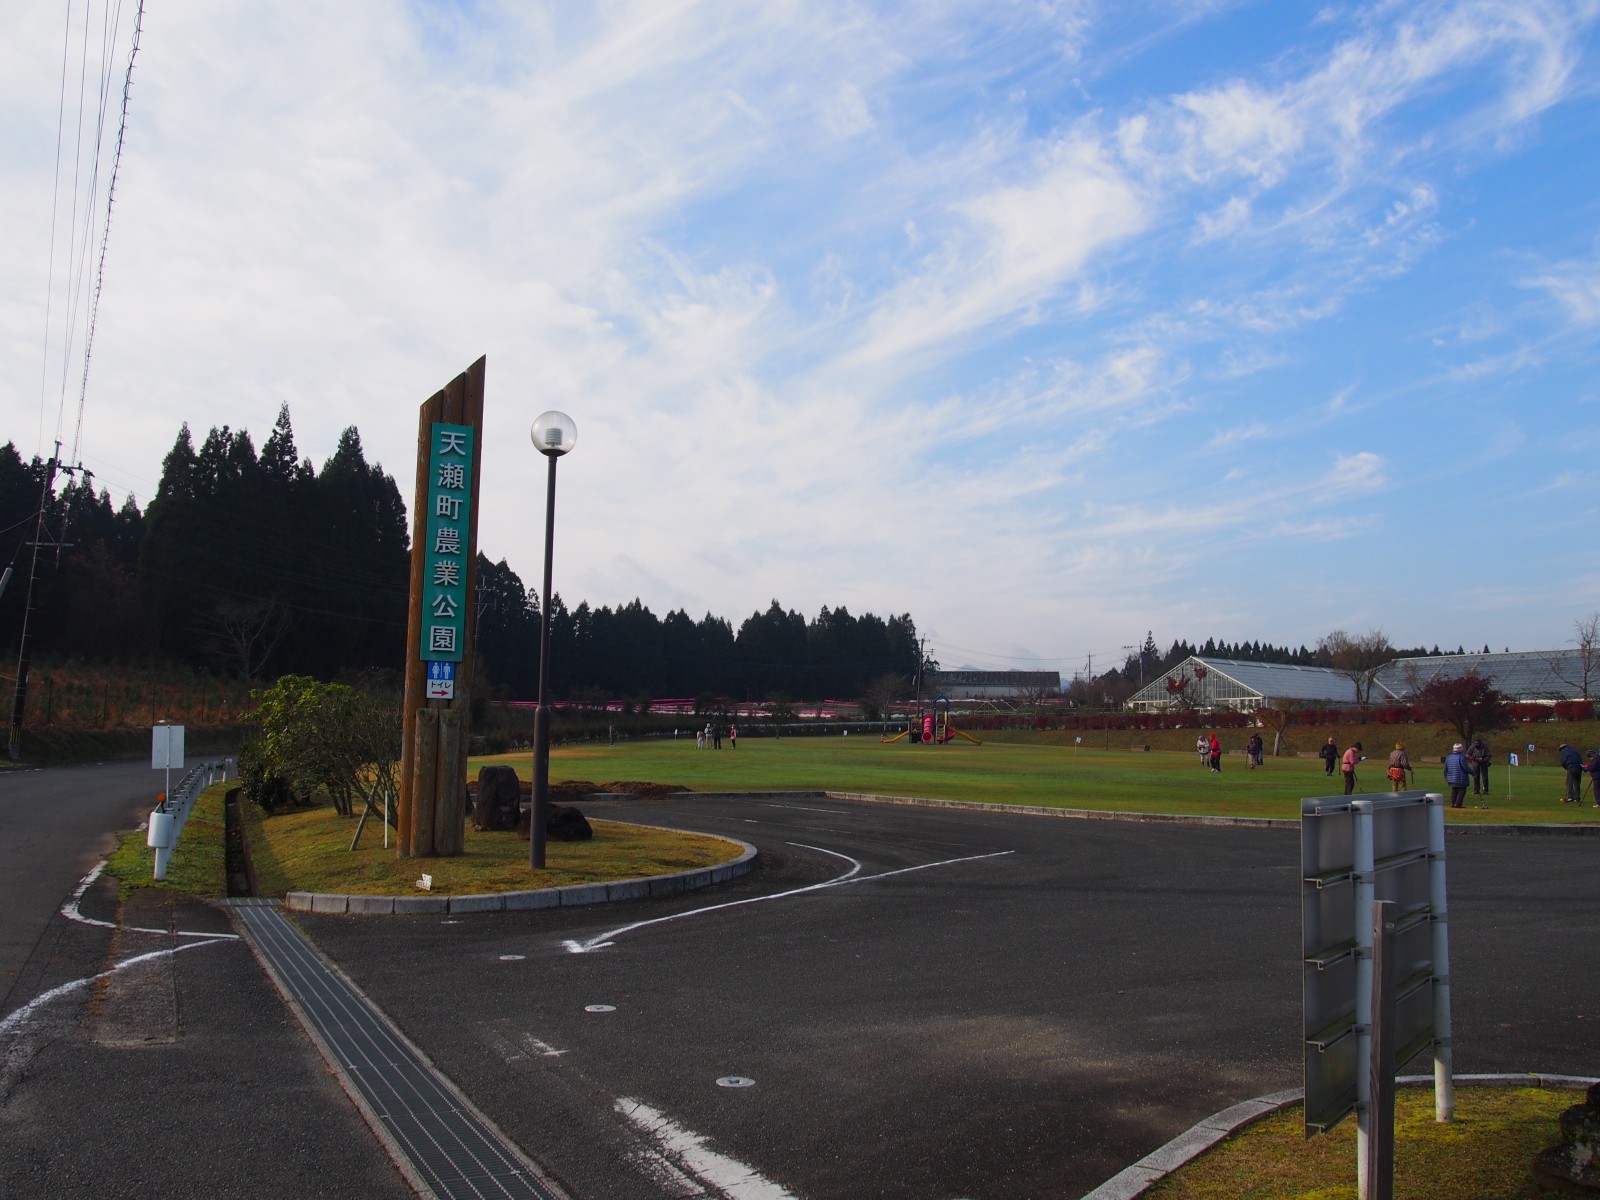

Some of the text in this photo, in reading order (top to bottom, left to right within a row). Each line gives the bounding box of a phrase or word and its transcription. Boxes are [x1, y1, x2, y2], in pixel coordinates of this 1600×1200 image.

[429, 431, 467, 652] 天瀬町農業公園
[431, 681, 452, 689] トイレ
